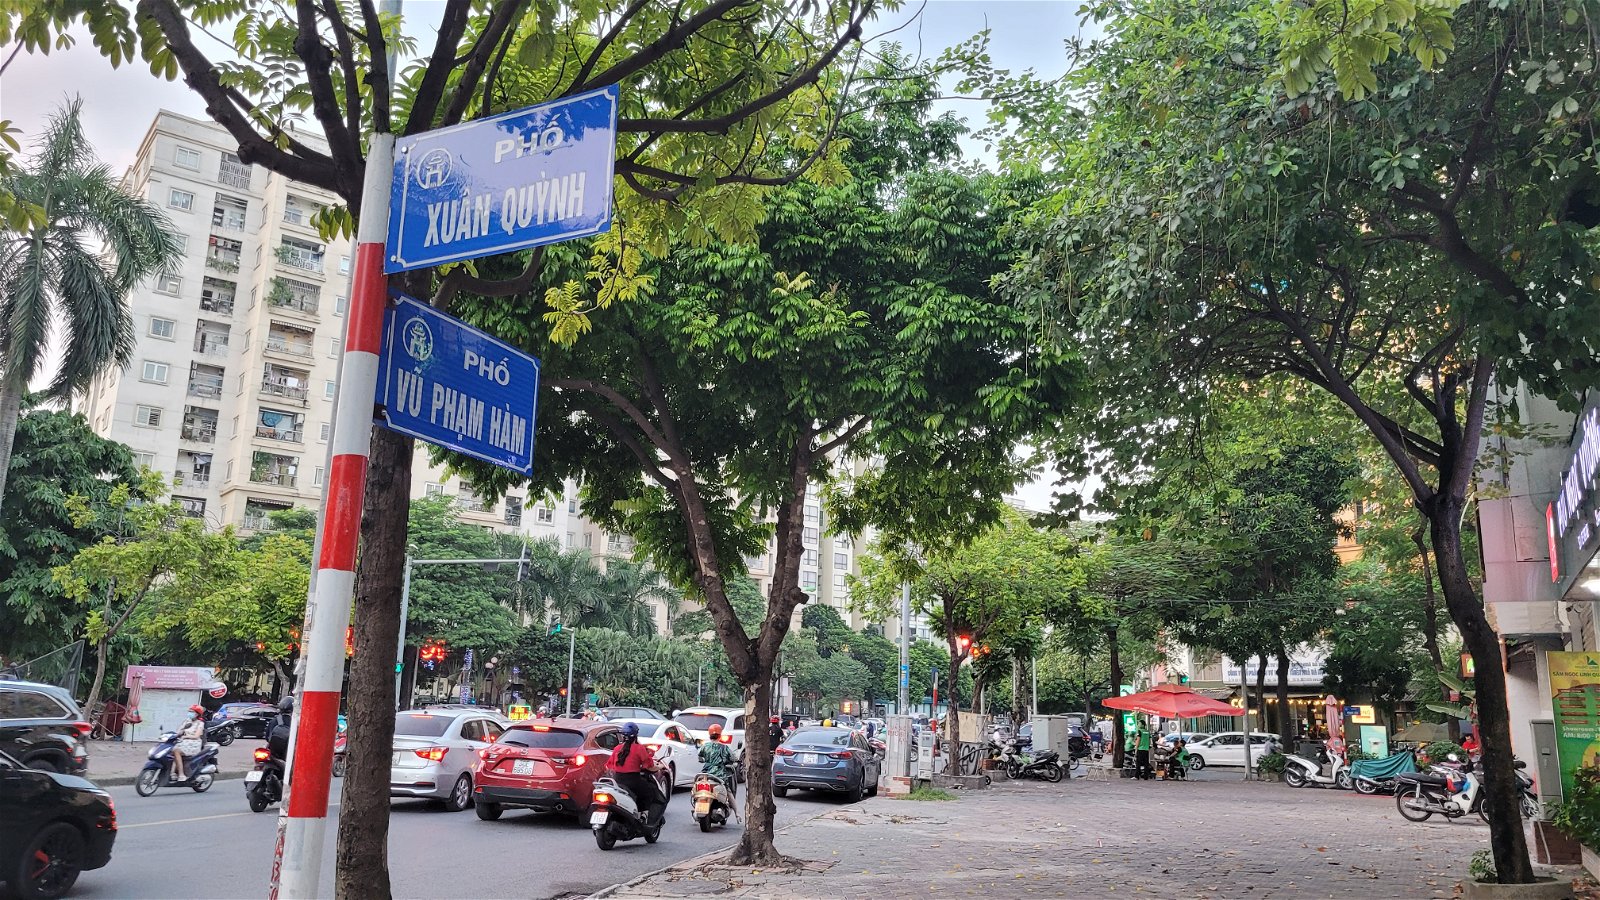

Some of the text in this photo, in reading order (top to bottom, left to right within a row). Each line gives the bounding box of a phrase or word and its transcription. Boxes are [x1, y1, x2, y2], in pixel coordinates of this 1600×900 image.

[494, 113, 563, 163] PHỐ
[423, 171, 586, 248] XUÂN QUỲNH
[463, 350, 510, 386] PHỐ
[396, 366, 526, 456] VŨ PHẠM HÀM
